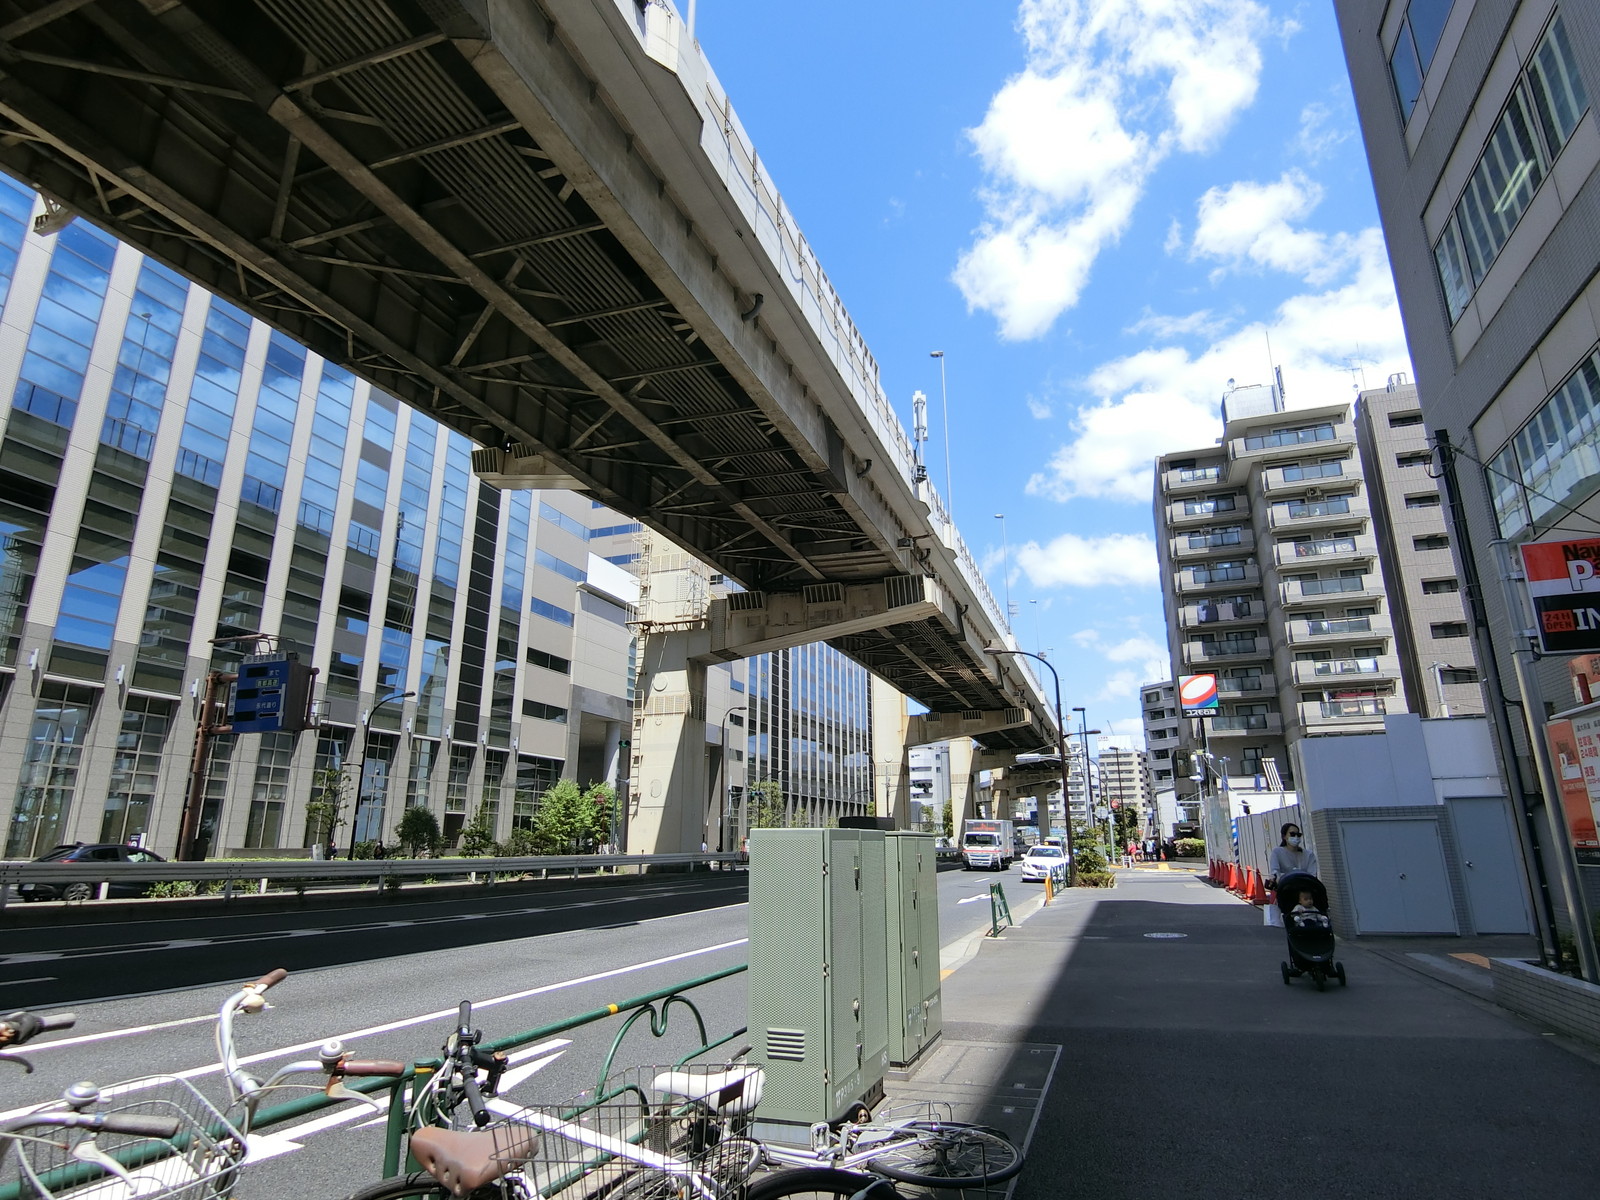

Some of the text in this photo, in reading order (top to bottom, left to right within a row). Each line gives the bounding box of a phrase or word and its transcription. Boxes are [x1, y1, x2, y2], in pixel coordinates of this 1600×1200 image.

[1546, 621, 1572, 630] OPEN
[1186, 708, 1216, 716] コスモ石油
